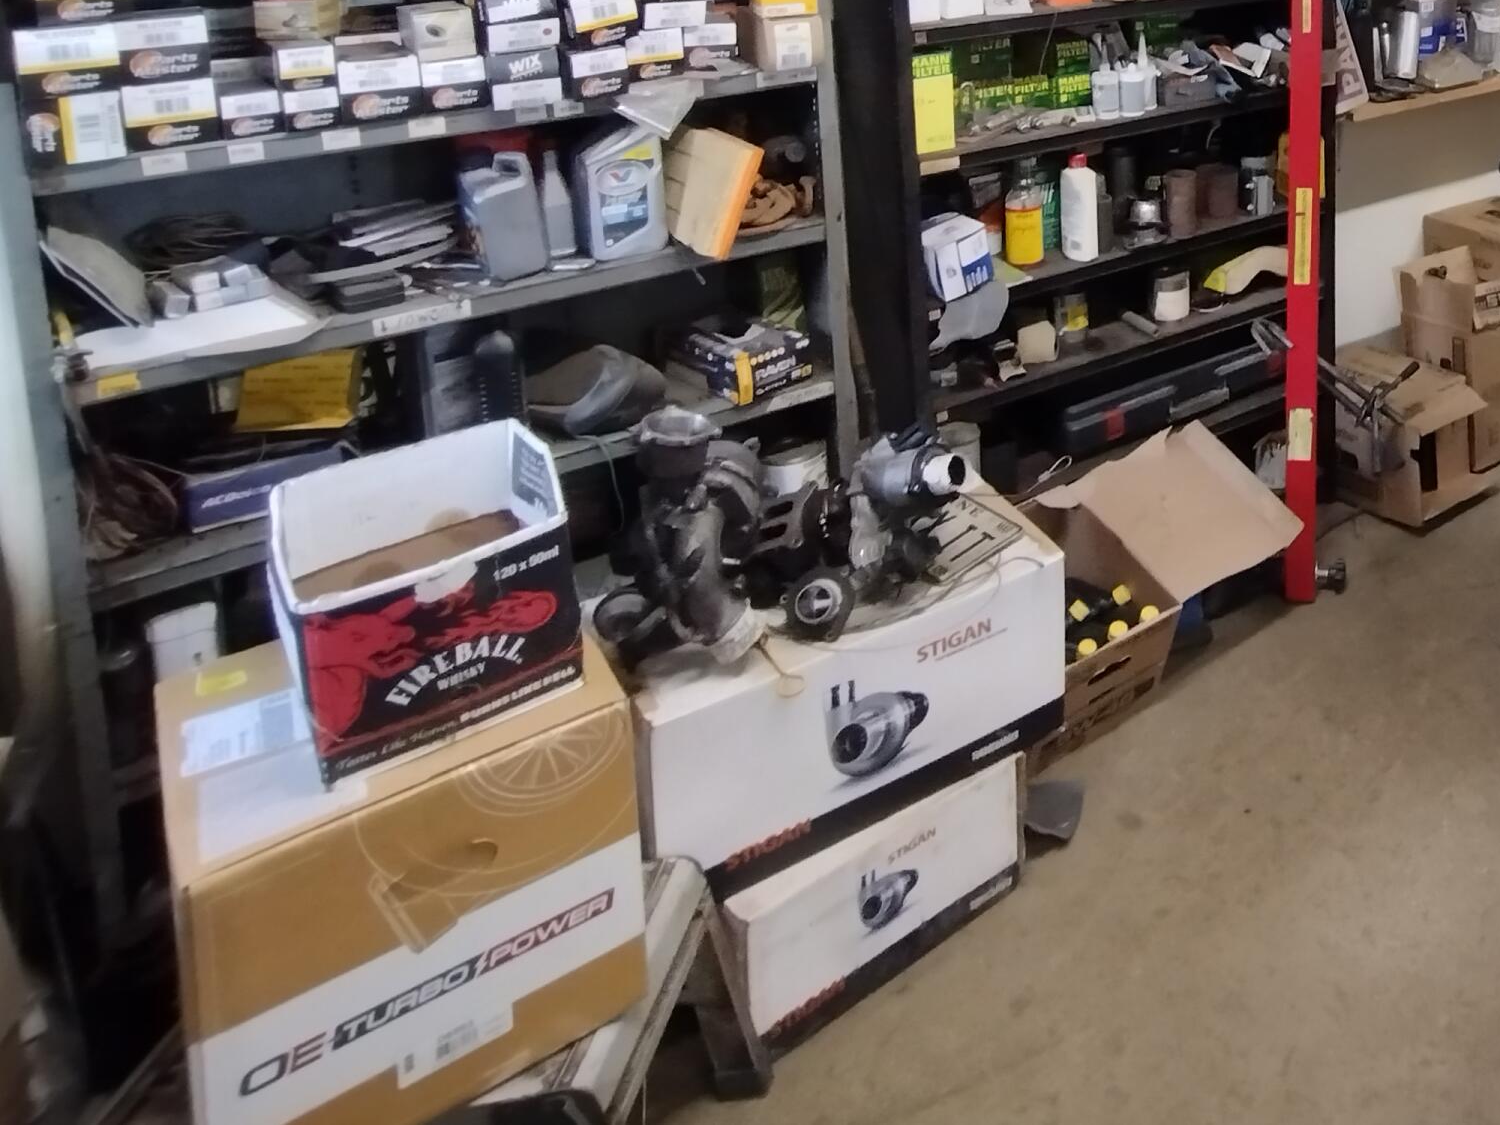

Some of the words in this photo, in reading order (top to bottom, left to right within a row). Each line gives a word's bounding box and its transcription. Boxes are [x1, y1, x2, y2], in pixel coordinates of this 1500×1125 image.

[508, 52, 542, 75] WIX
[1057, 48, 1089, 59] FILTER
[1059, 74, 1090, 85] MANN
[1060, 81, 1090, 94] FILTER
[493, 561, 518, 582] 120
[916, 618, 993, 664] STIGAN
[384, 633, 526, 708] FIREBALL
[436, 661, 487, 692] WHISKY
[724, 817, 813, 872] STIGAN
[887, 826, 938, 866] STIGAN
[489, 889, 614, 968] POWER
